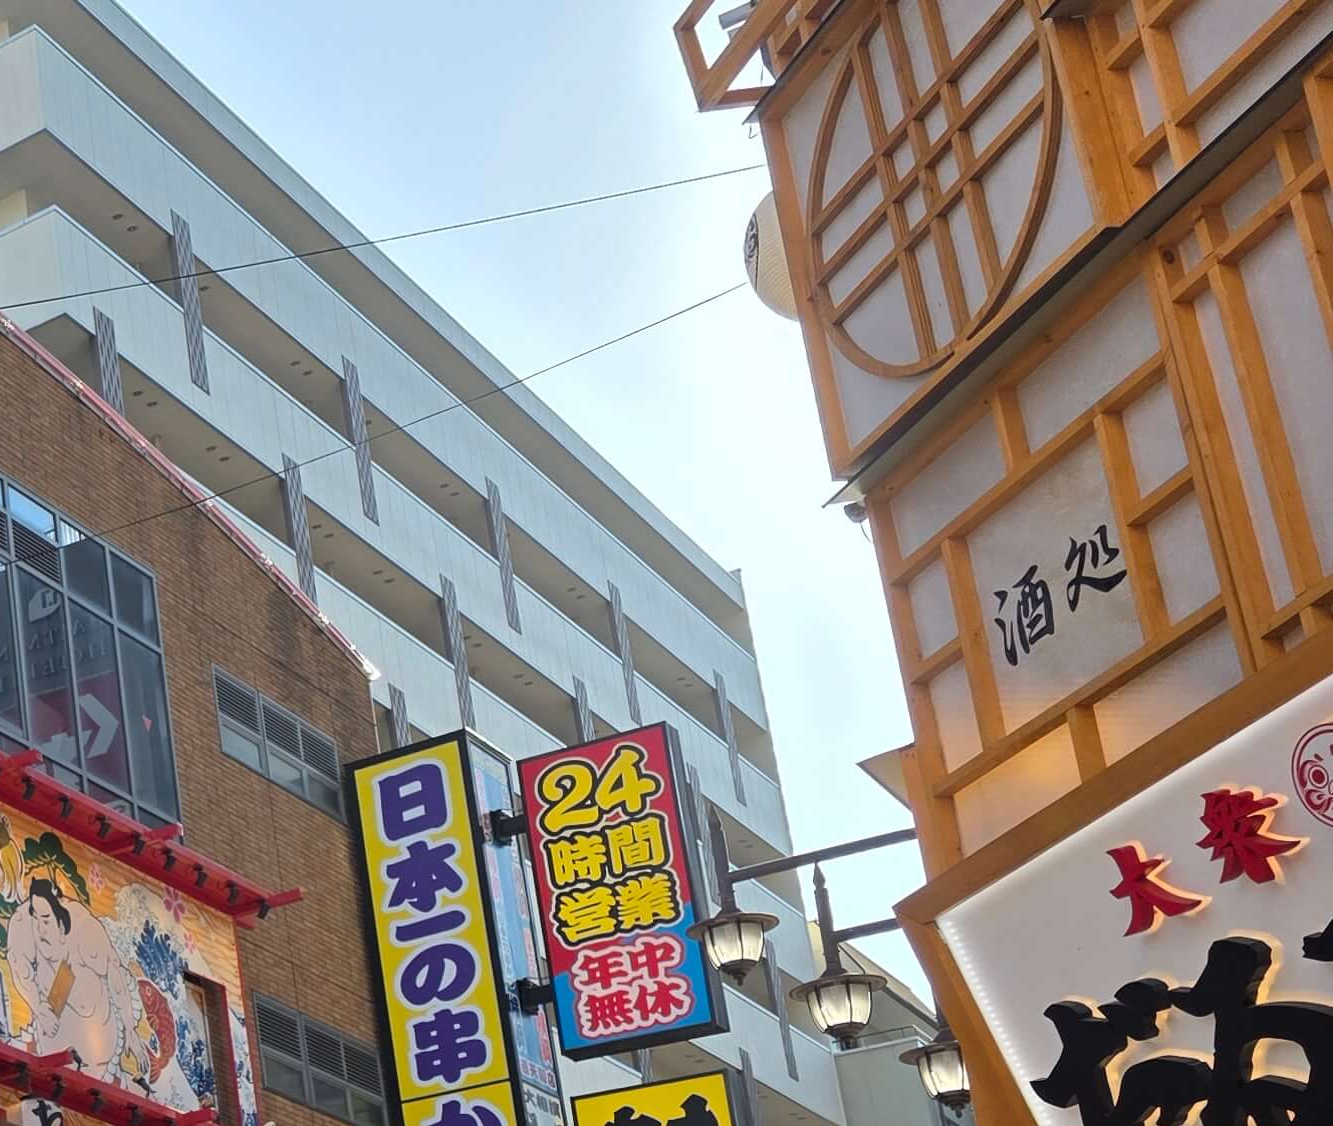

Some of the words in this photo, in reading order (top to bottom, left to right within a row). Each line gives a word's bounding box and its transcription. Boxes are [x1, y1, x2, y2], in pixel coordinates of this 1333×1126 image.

[538, 745, 661, 834] 24
[546, 819, 669, 886] 時間
[554, 876, 676, 942] 営業
[577, 942, 680, 992] 年中
[582, 982, 688, 1032] 無休
